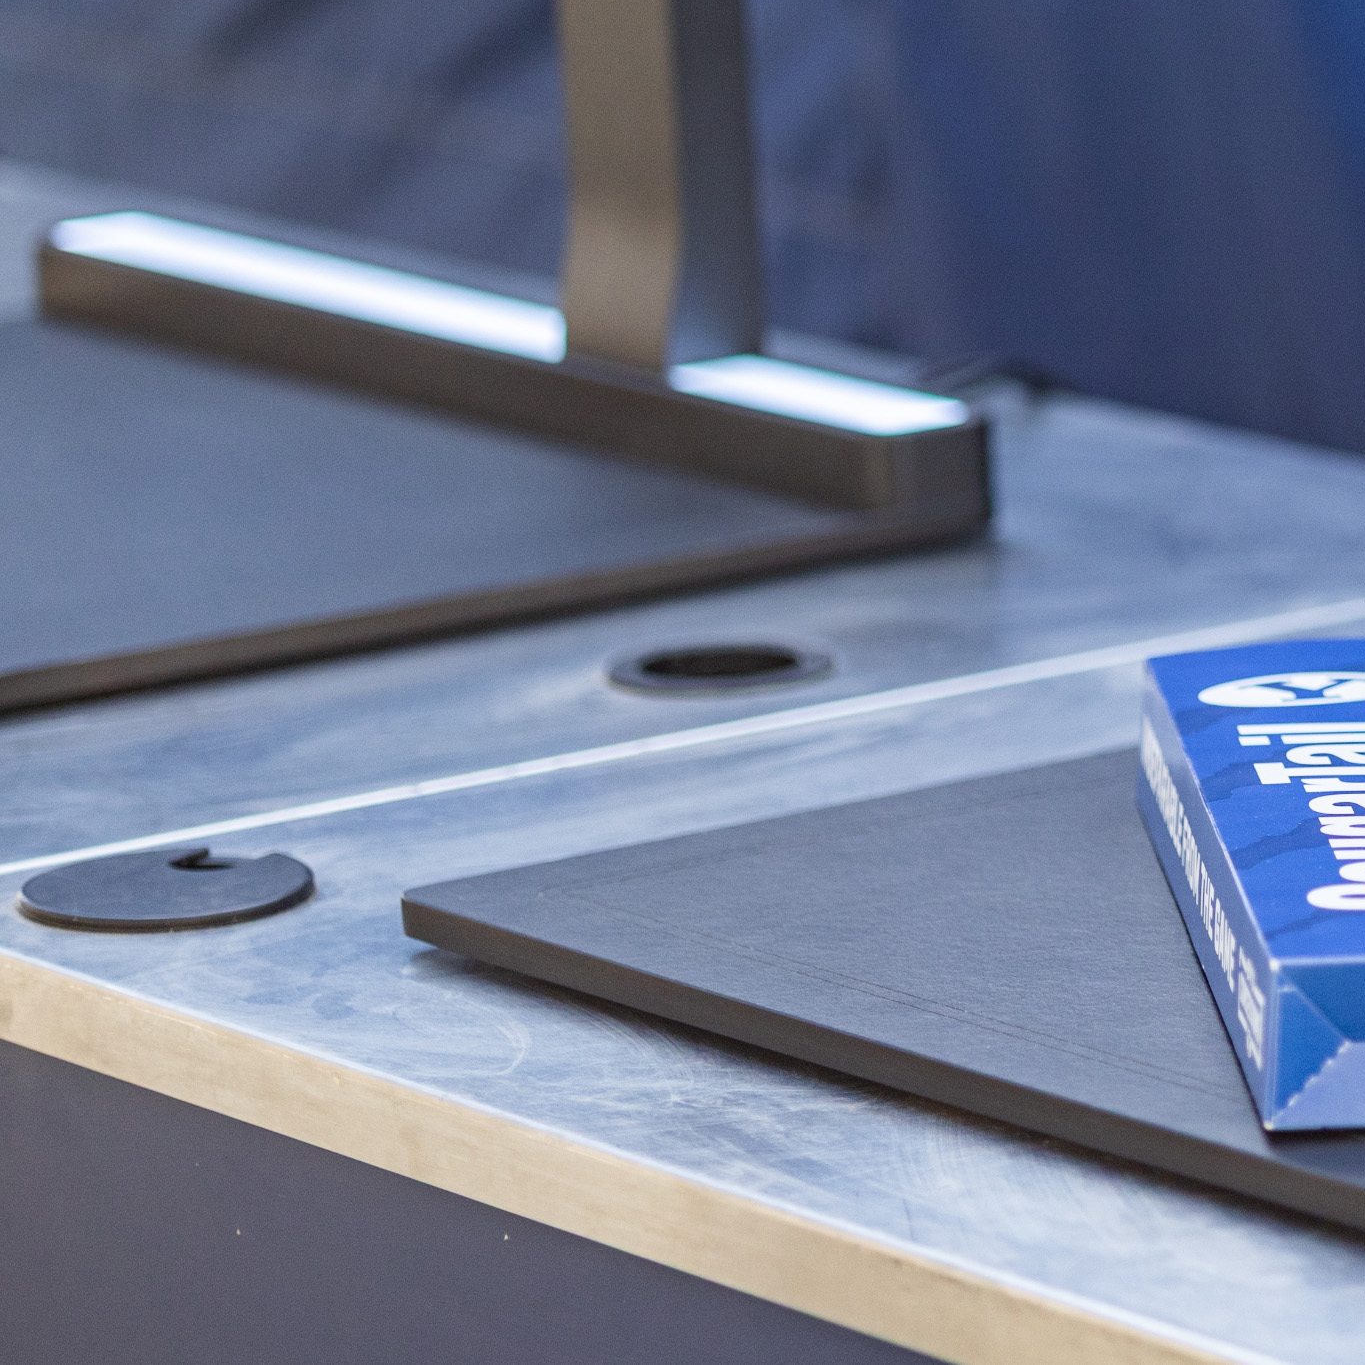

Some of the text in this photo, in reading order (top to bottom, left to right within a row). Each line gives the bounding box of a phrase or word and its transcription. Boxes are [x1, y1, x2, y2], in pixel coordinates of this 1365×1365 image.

[1180, 816, 1201, 905] FROM
[1200, 860, 1215, 941] THE
[1213, 897, 1236, 994] GAME
